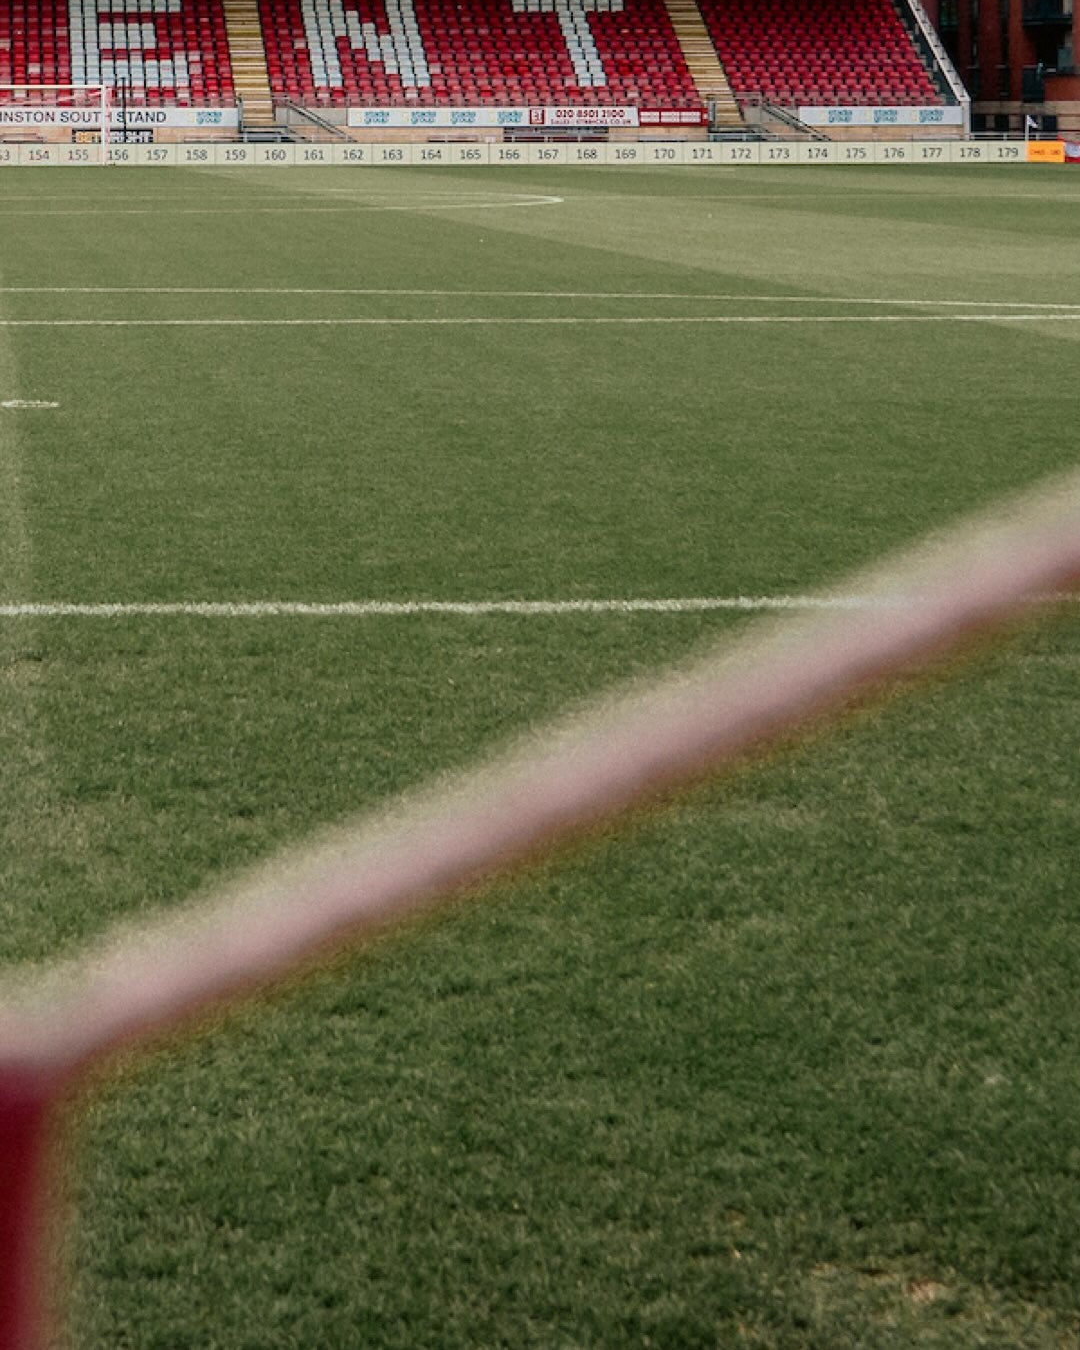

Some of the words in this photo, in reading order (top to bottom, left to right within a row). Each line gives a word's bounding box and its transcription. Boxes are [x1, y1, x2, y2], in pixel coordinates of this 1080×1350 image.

[0, 111, 55, 123] NSTON
[116, 111, 167, 123] STAND
[29, 150, 50, 161] 154
[69, 150, 89, 161] 155
[147, 150, 169, 161] 157
[187, 150, 208, 161] 158
[225, 149, 247, 161] 159
[265, 149, 287, 161] 160
[304, 149, 325, 161] 161
[344, 149, 364, 161] 162
[383, 149, 404, 161] 163
[421, 149, 442, 161] 164
[461, 149, 482, 160] 165
[499, 149, 521, 160] 166
[539, 149, 560, 160] 167
[578, 149, 598, 160] 168
[616, 149, 637, 160] 169
[655, 149, 676, 160] 170
[693, 148, 713, 160] 171
[731, 148, 752, 159] 172
[769, 148, 790, 159] 173
[808, 148, 828, 159] 174
[847, 148, 867, 159] 175
[884, 148, 905, 159] 176
[922, 148, 943, 159] 177
[960, 147, 981, 158] 178
[998, 147, 1019, 158] 179
